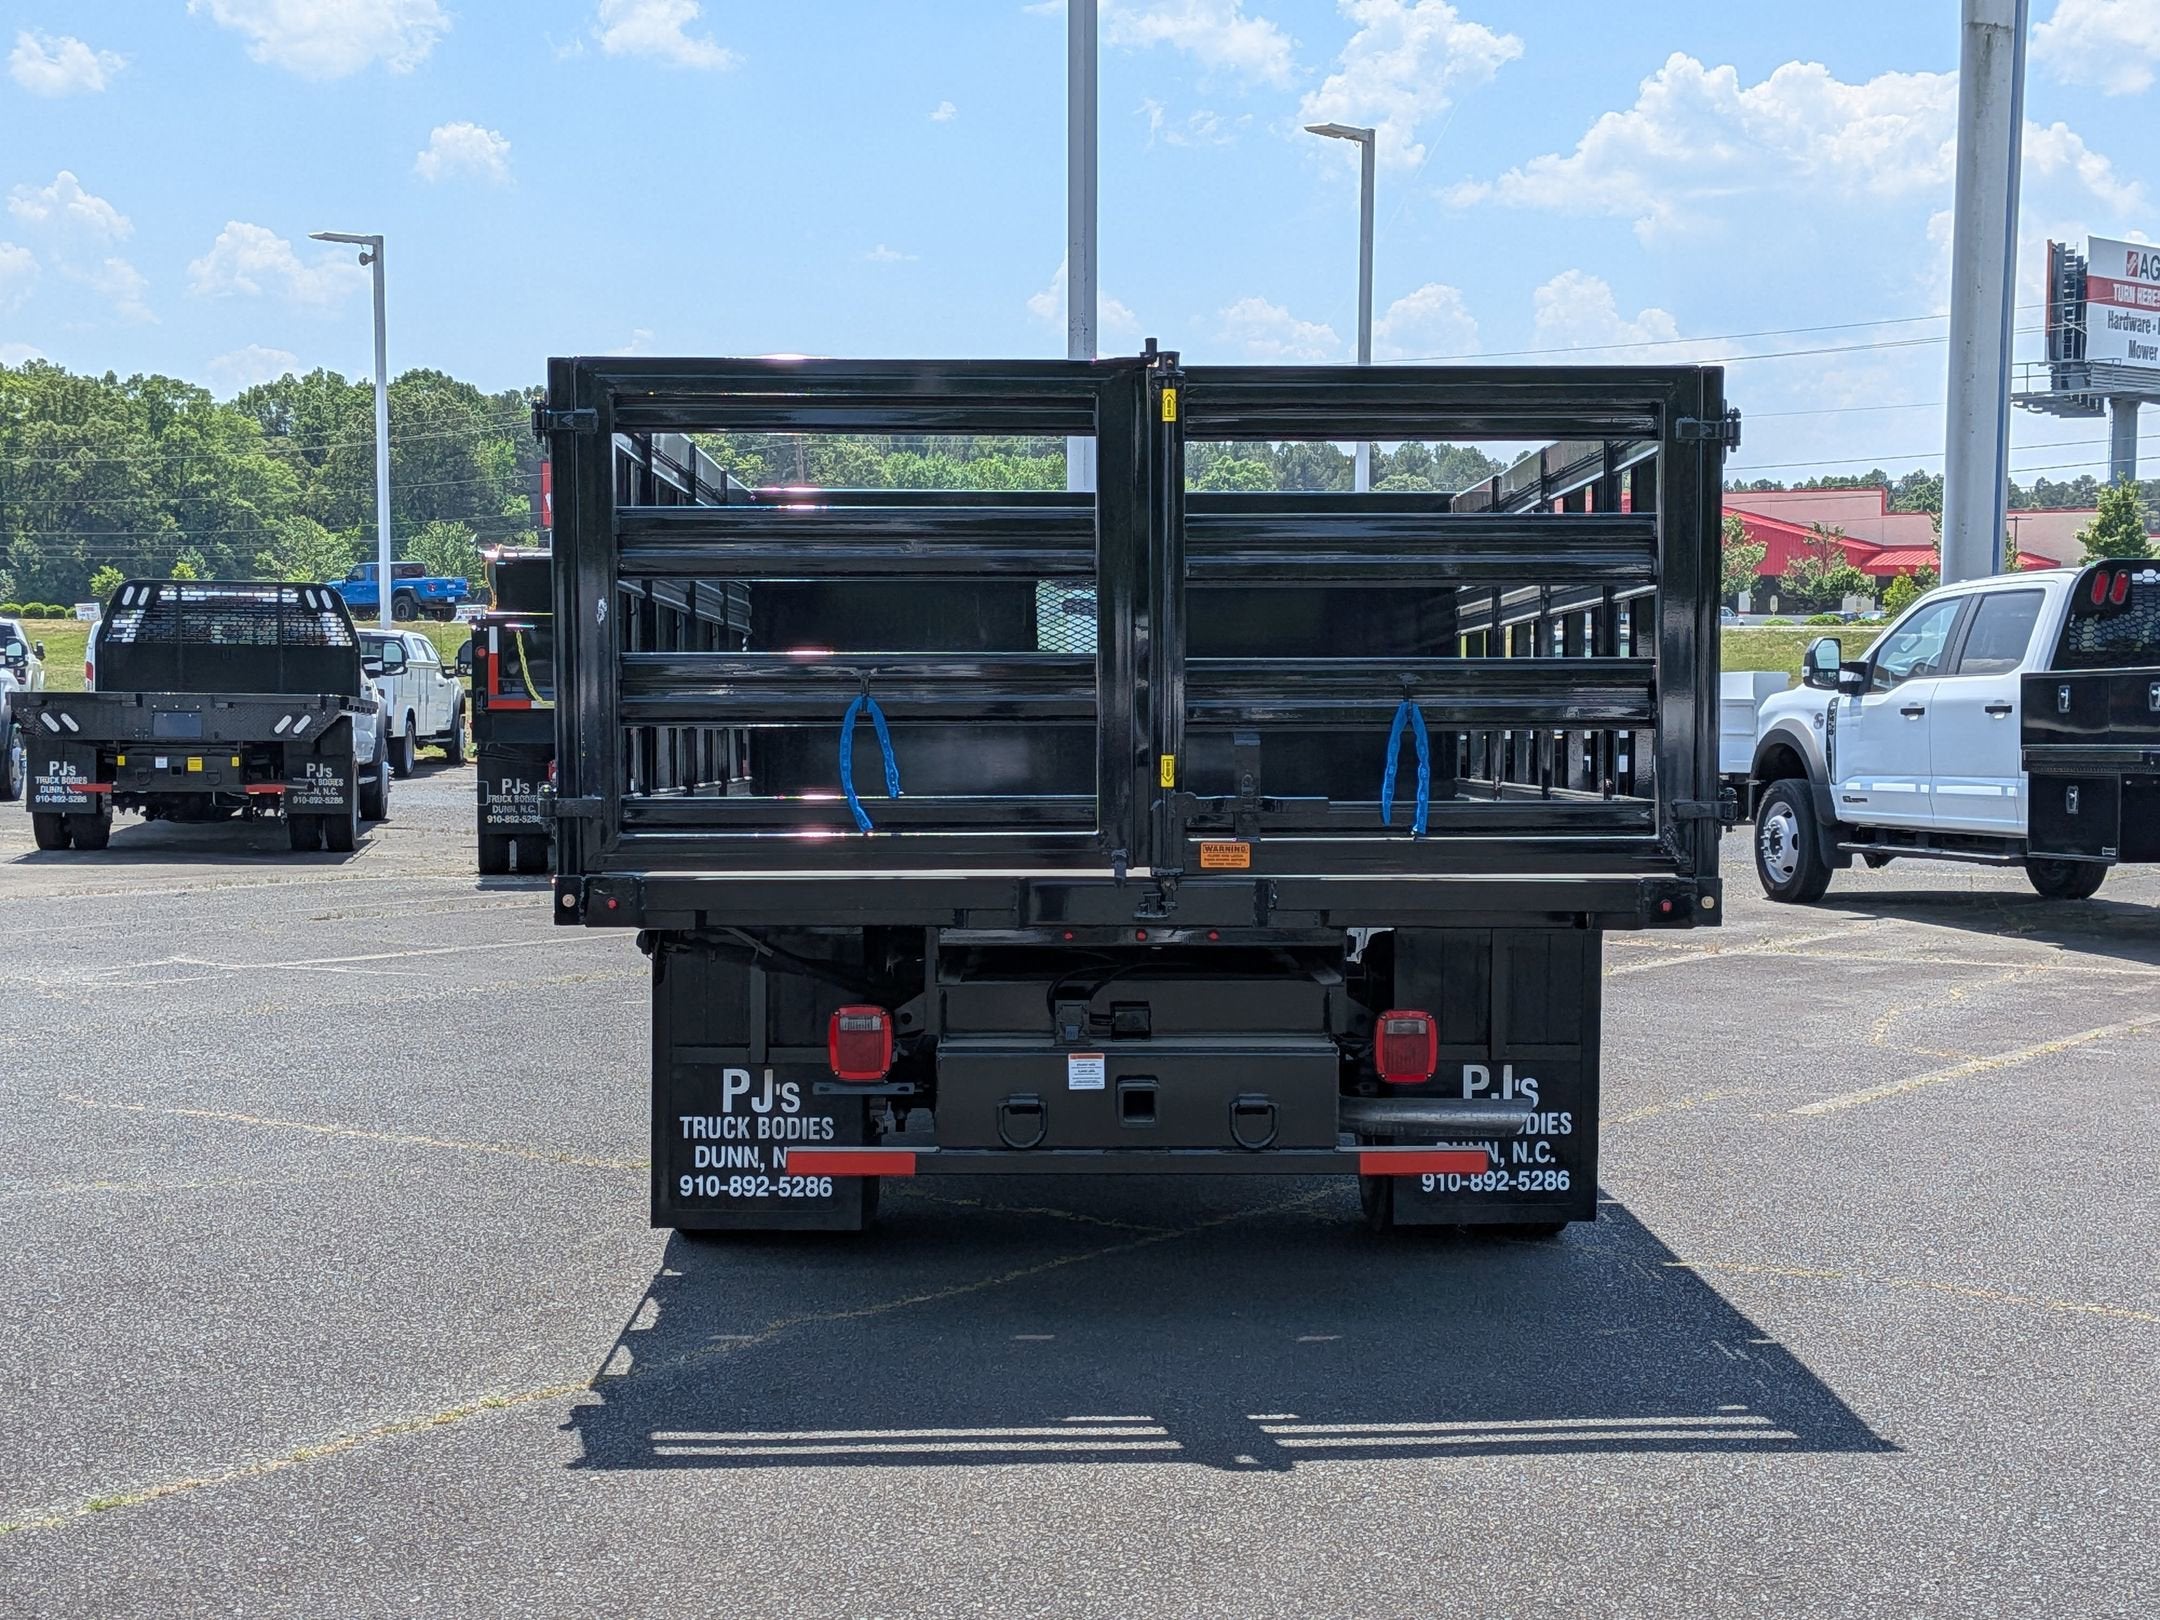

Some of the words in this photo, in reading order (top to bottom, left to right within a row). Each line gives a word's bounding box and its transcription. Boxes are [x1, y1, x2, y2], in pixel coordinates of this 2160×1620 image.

[2107, 310, 2151, 334] Hardware
[2128, 340, 2158, 361] Mower
[1204, 845, 1246, 853] WARNING
[680, 1116, 750, 1139] TRUCK
[758, 1116, 835, 1140] BODIES
[695, 1146, 766, 1173] DUNN,
[1513, 1141, 1556, 1164] N.C.
[680, 1176, 833, 1198] 910-892-5286
[1421, 1170, 1571, 1193] 910-892-5286
